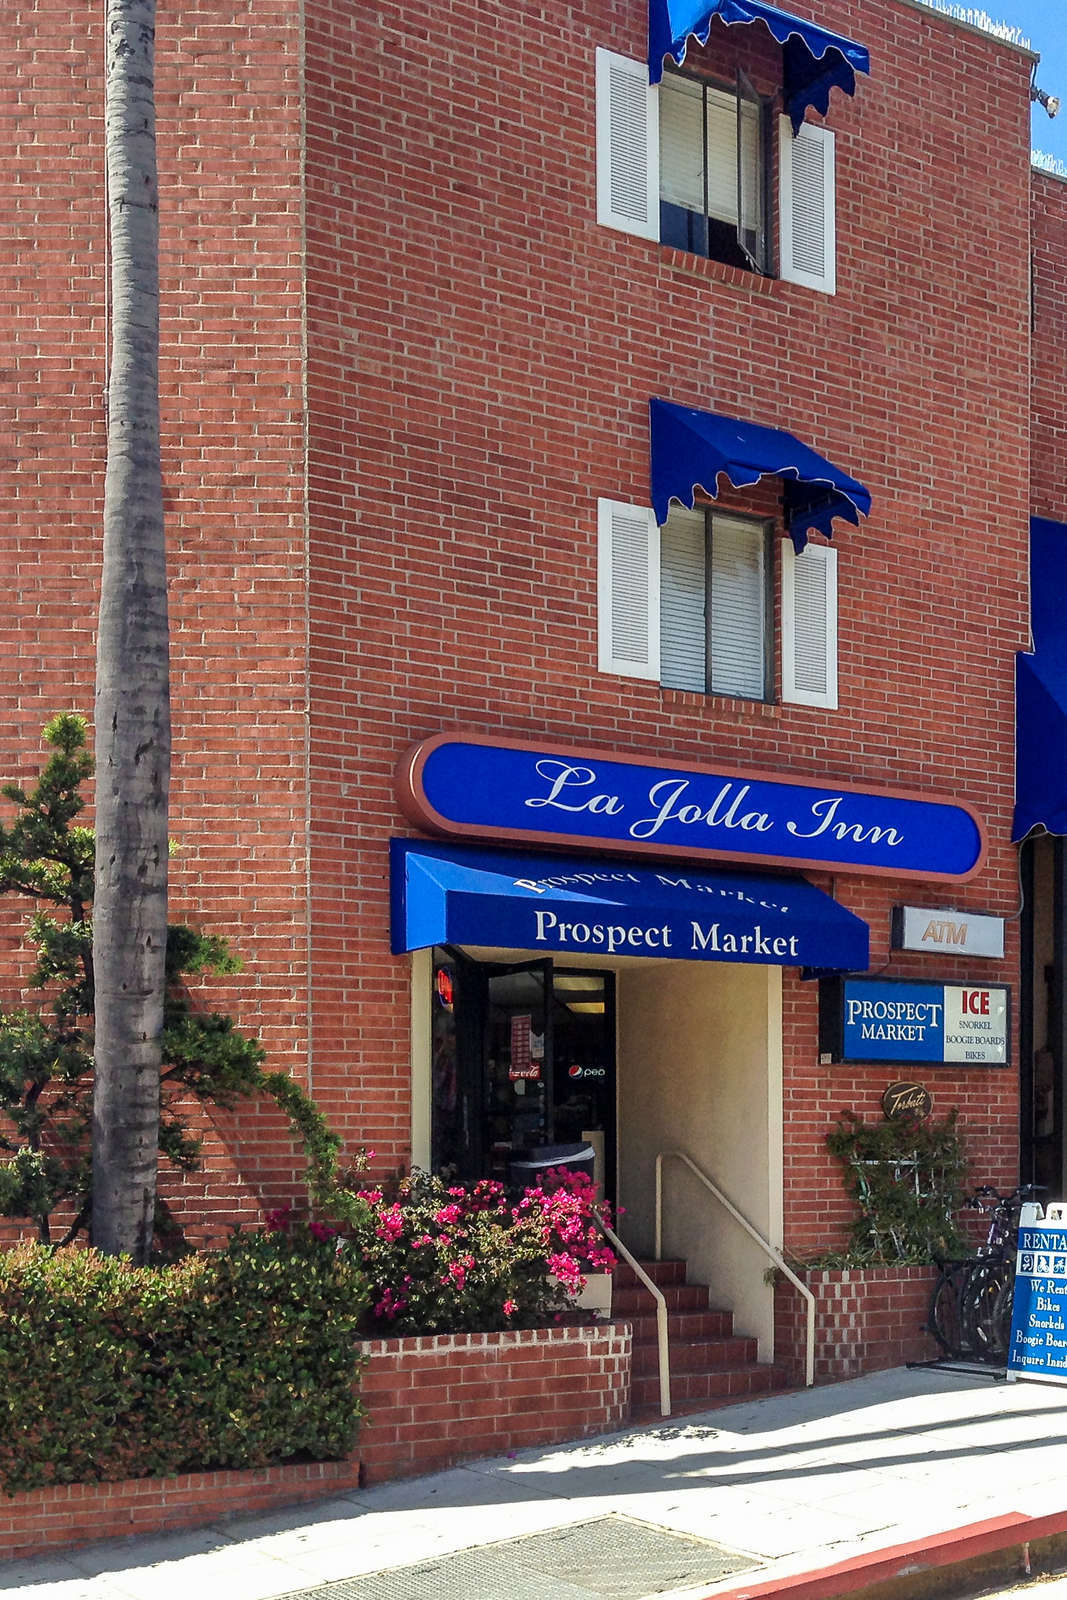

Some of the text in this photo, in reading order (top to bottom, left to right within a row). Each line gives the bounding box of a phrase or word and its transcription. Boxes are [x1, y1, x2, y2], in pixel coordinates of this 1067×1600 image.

[524, 759, 904, 846] La Jolla Inn
[513, 872, 641, 894] Prospect
[534, 910, 799, 957] Prospect Market
[921, 919, 968, 946] ATM
[962, 990, 990, 1015] ICE
[846, 999, 943, 1027] PROSPECT
[861, 1023, 926, 1041] MARKET
[959, 1020, 993, 1030] SNORKEL
[946, 1034, 1005, 1046] BOOGIE BOARDS
[965, 1051, 986, 1060] BIKES
[1031, 1279, 1045, 1293] We
[1036, 1297, 1061, 1312] Bikes
[1028, 1313, 1065, 1330] Snorkels
[1015, 1329, 1044, 1347] Boogie
[1012, 1349, 1045, 1366] Inquire
